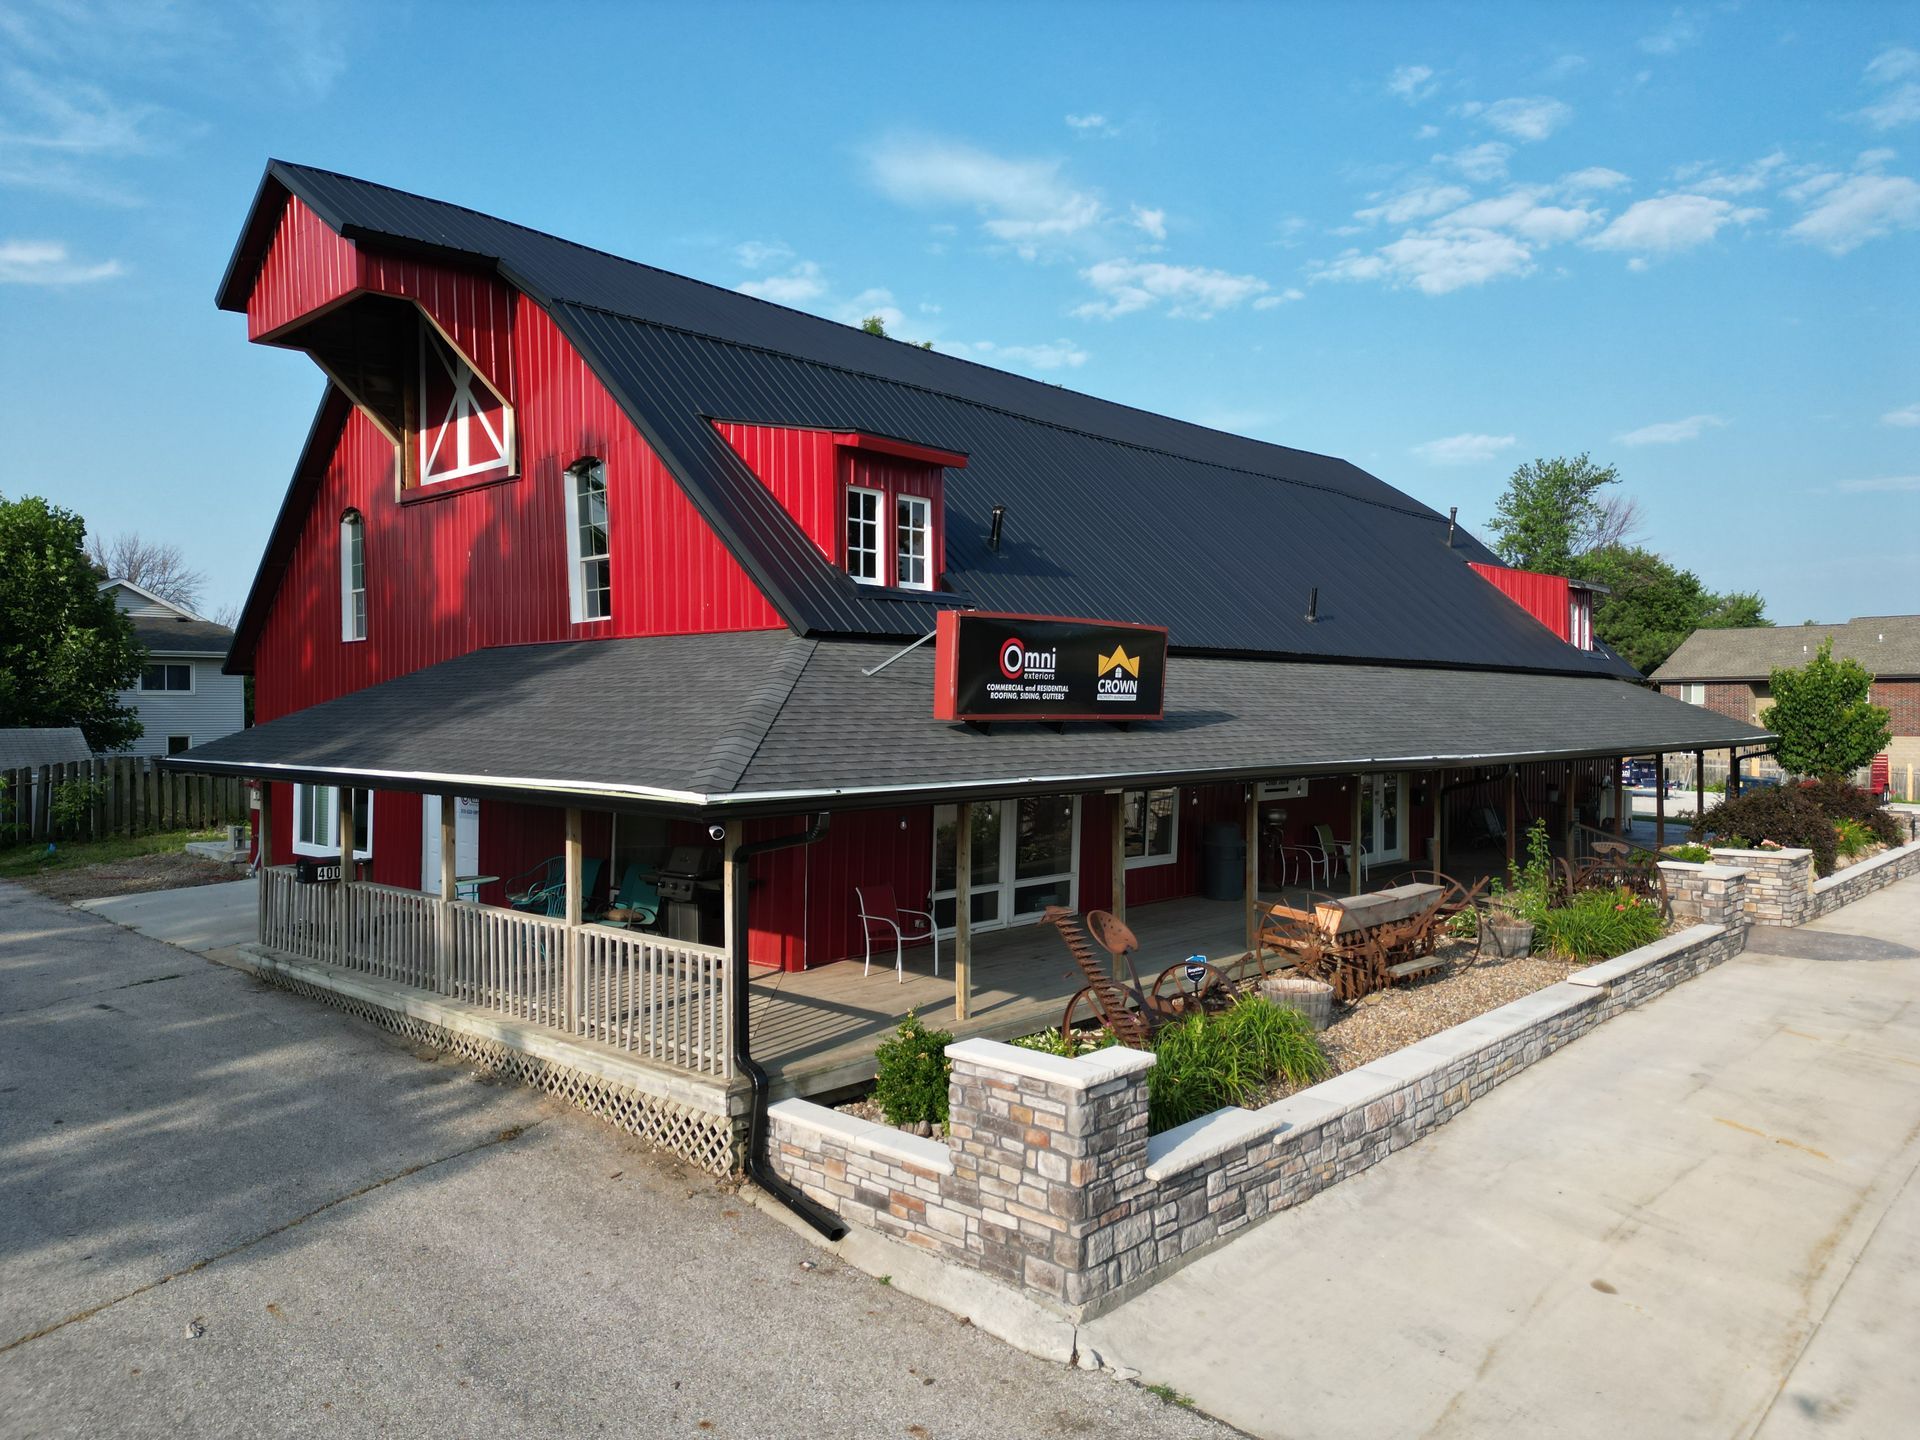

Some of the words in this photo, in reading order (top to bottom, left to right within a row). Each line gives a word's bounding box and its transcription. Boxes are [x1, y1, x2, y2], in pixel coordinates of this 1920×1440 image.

[1001, 641, 1056, 676] Omni
[986, 683, 1024, 691] COMMERCIAL
[1025, 684, 1036, 692] and
[1098, 679, 1138, 693] CROWN
[990, 692, 1018, 700] ROOFING,
[1020, 692, 1040, 700] SIDING,
[318, 867, 341, 879] 400
